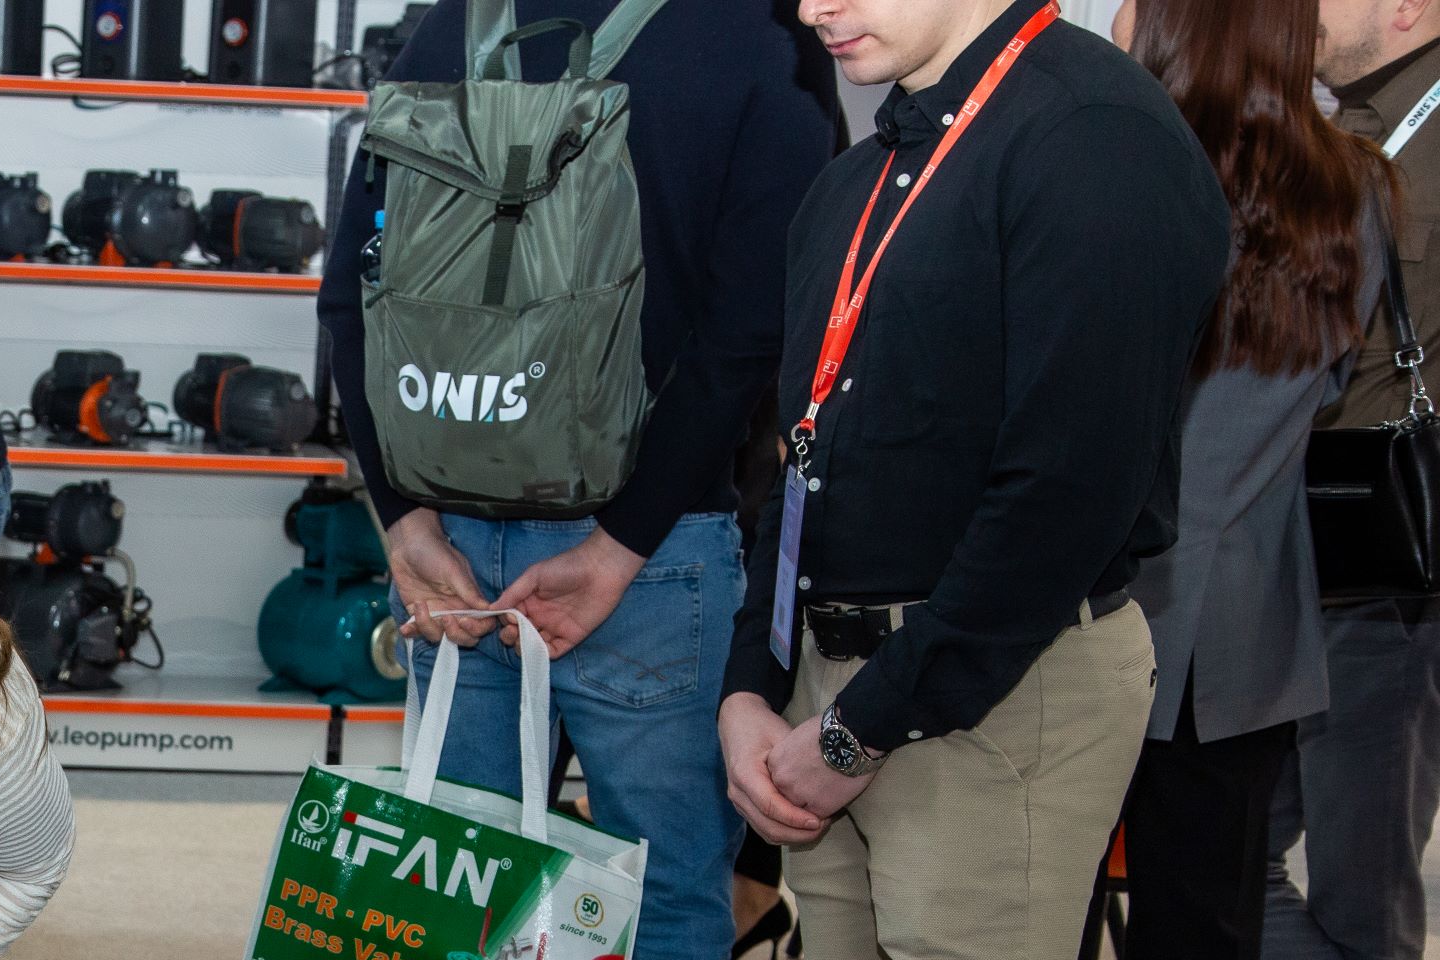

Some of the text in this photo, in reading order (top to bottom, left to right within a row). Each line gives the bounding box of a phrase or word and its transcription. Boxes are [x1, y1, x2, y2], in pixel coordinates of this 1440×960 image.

[280, 877, 427, 949] PPR PVC
[581, 897, 599, 915] 50
[264, 904, 344, 955] Brass
[559, 923, 608, 945] since 1993
